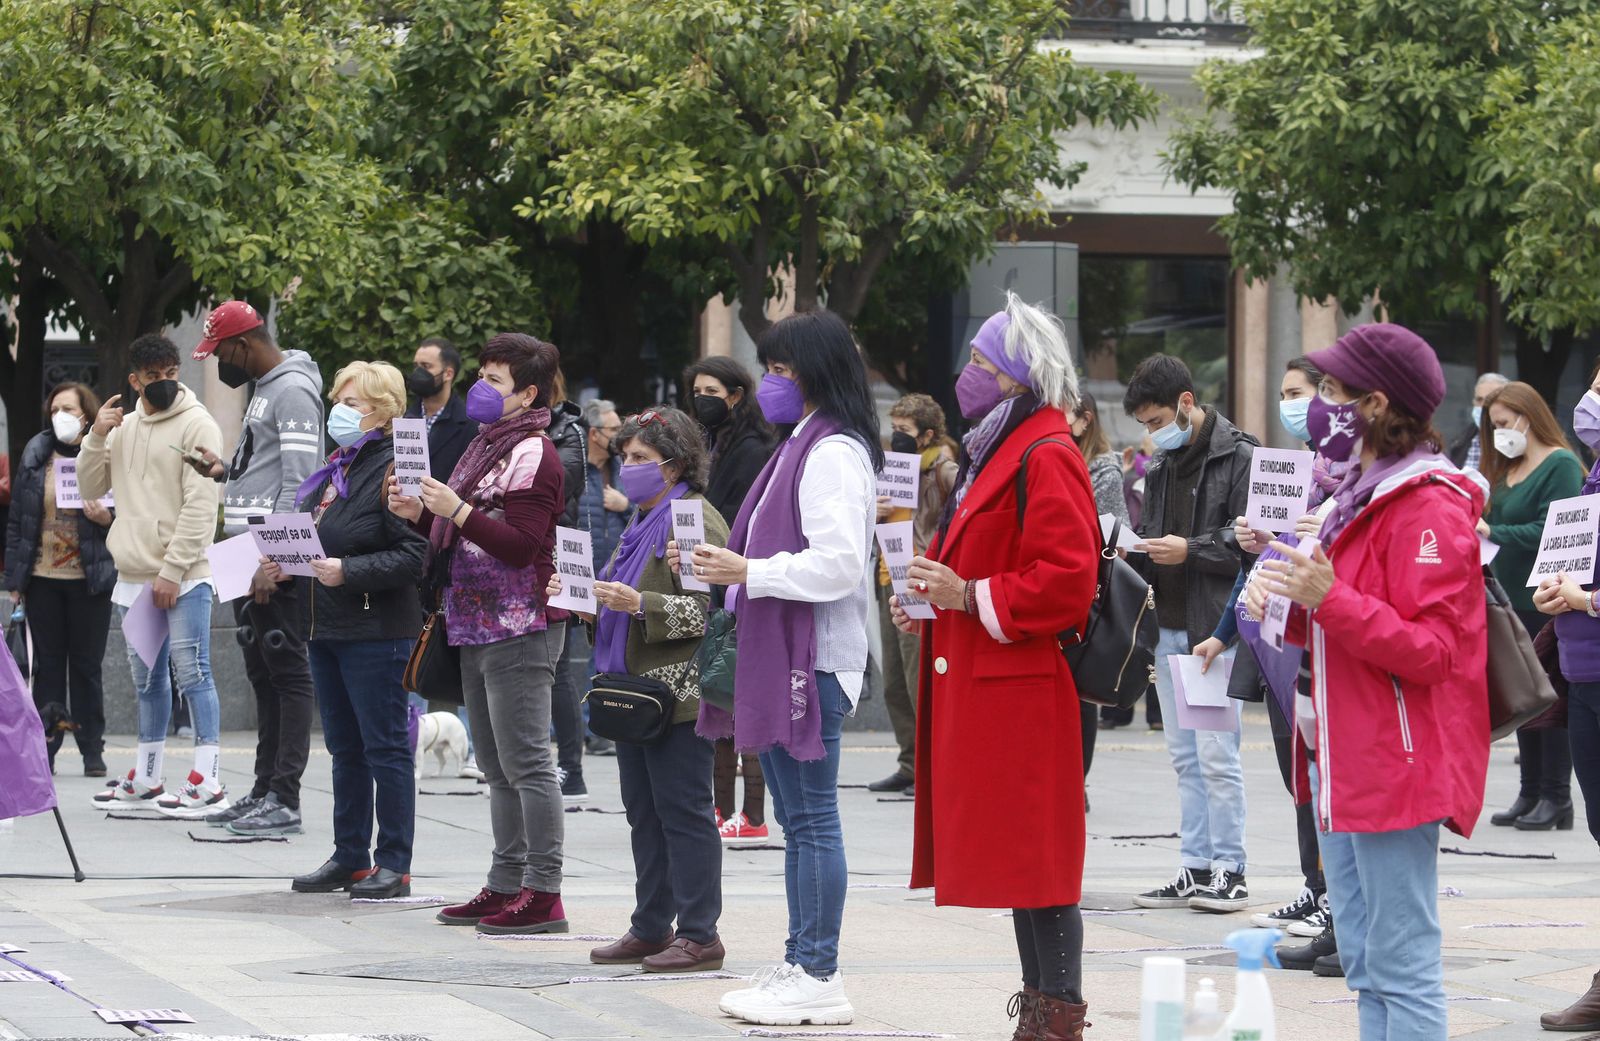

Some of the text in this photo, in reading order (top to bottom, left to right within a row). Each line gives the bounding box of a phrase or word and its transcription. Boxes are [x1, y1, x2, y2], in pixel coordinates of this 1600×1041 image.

[1252, 482, 1269, 495] REPARTO
[1278, 484, 1303, 498] TRABAJO
[1261, 505, 1288, 520] EN EL HOGAR
[289, 528, 300, 540] es
[301, 528, 312, 539] no
